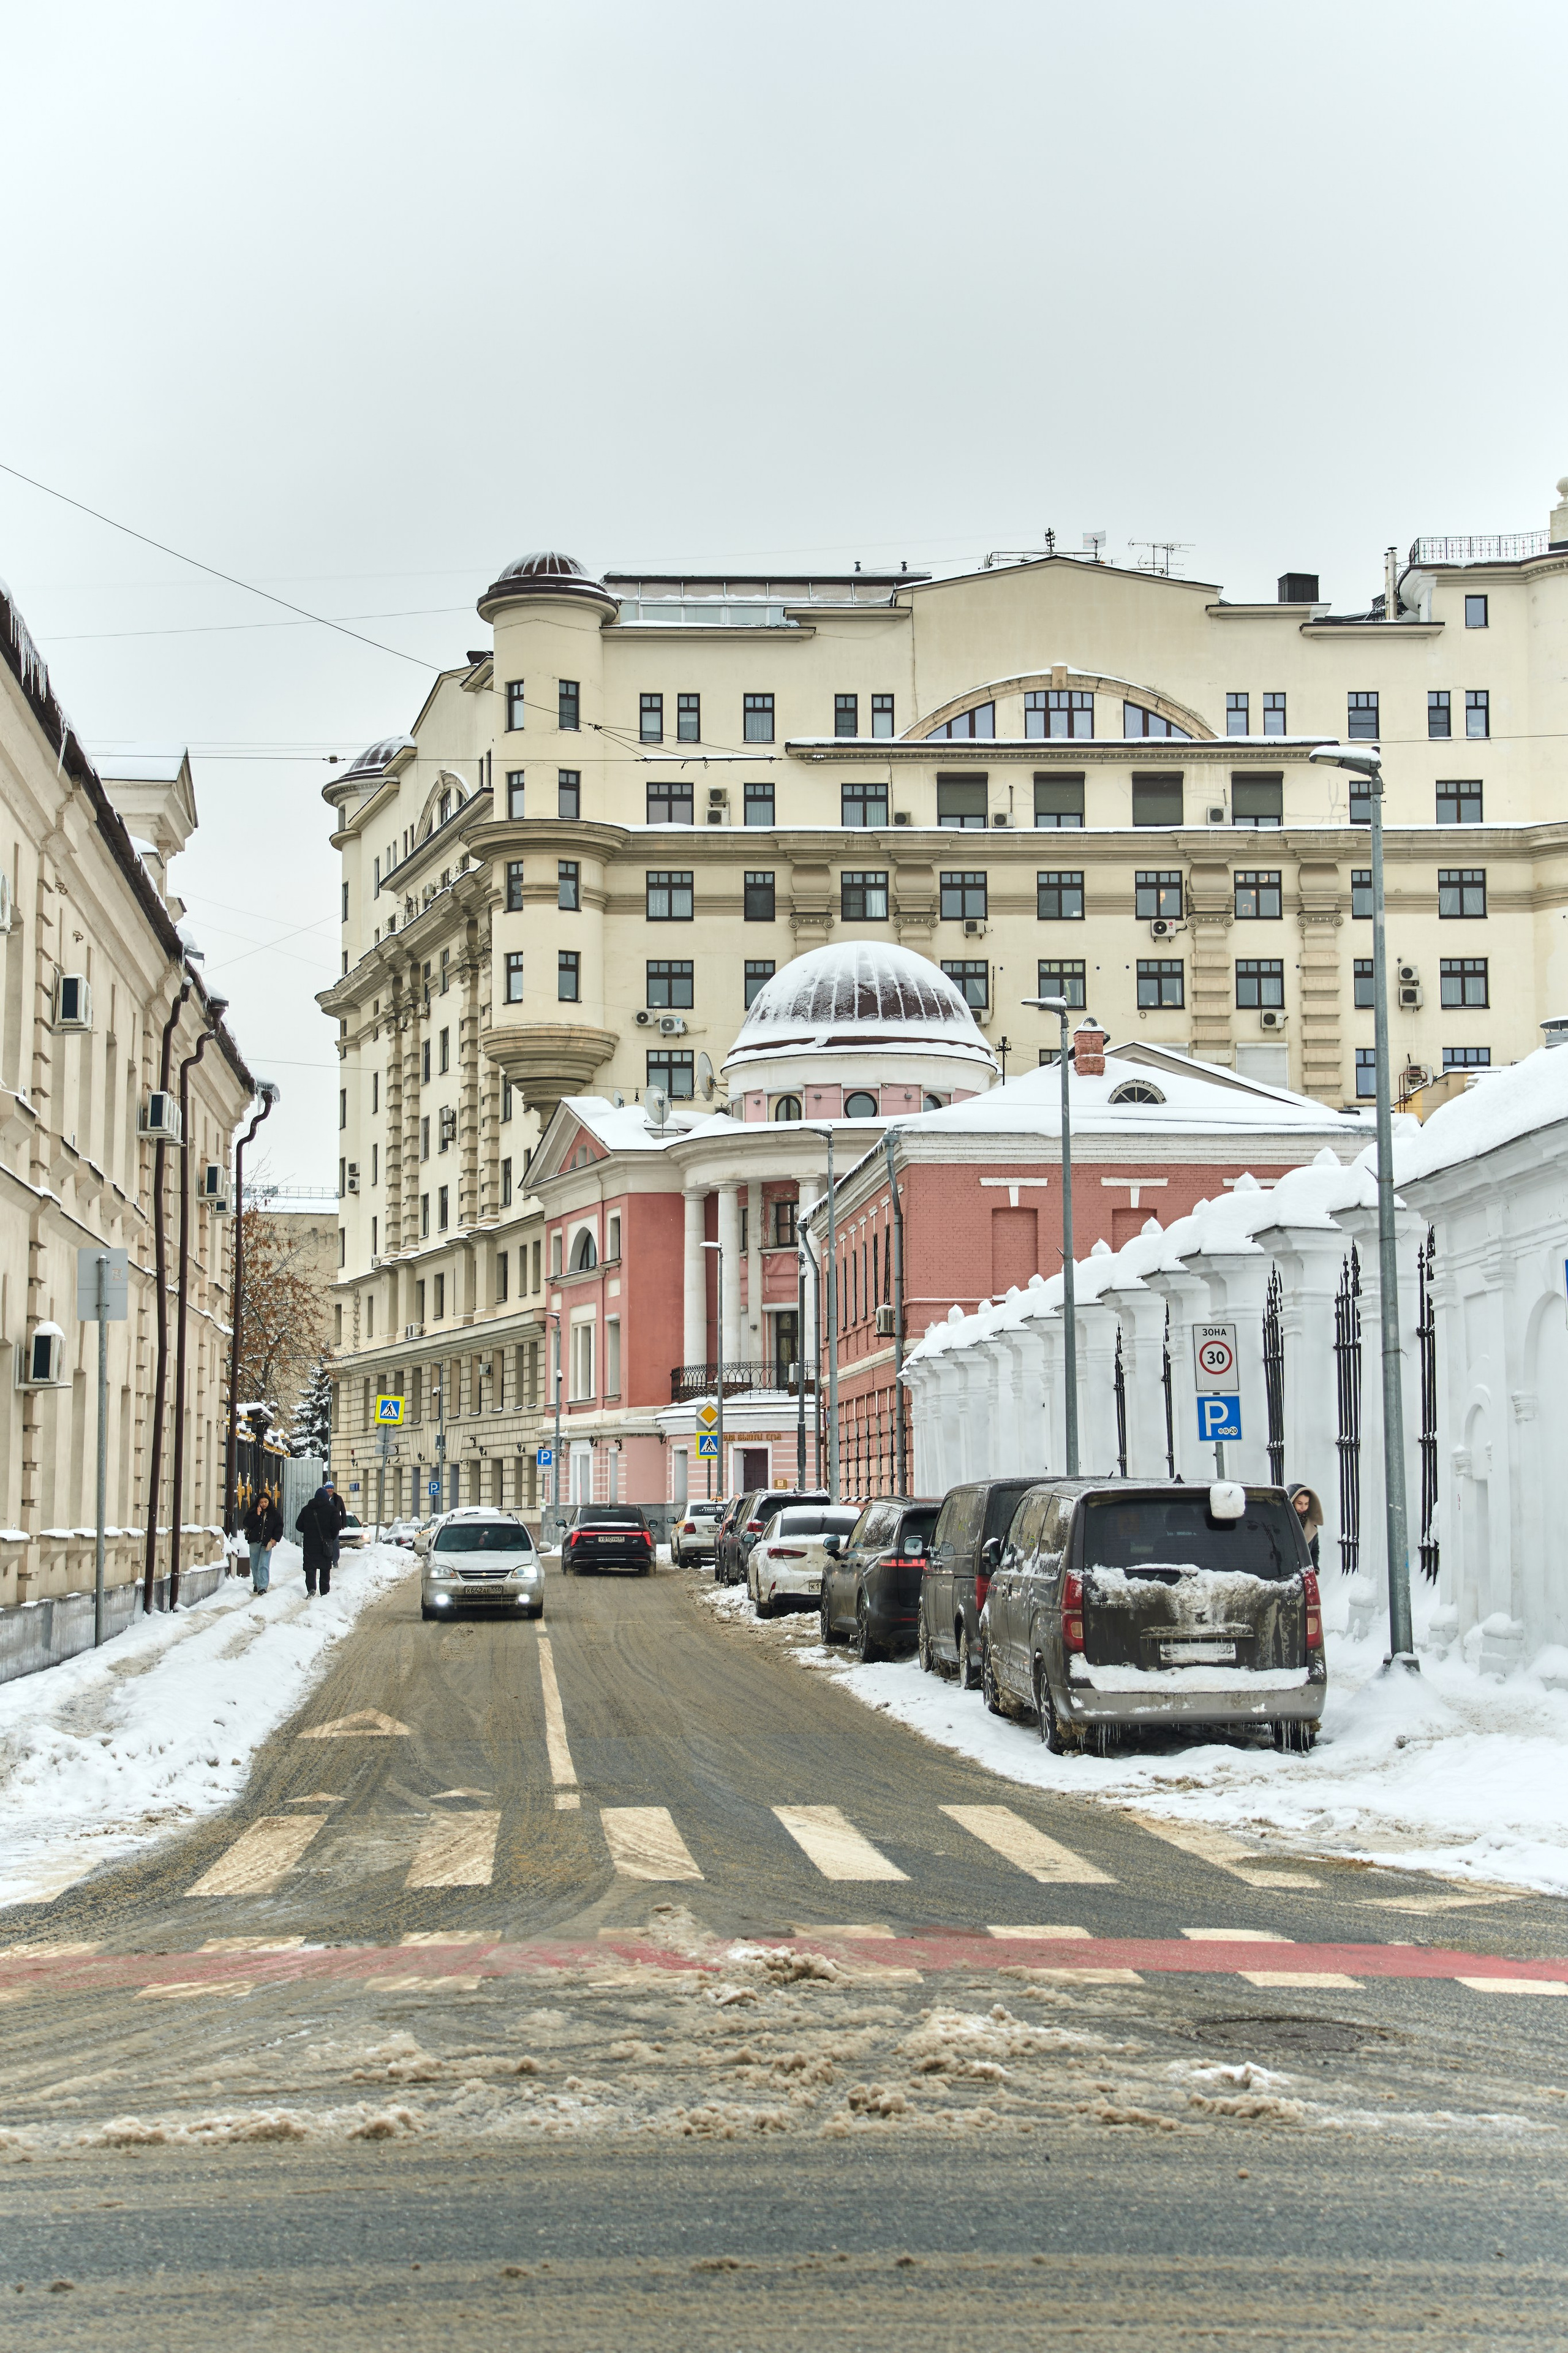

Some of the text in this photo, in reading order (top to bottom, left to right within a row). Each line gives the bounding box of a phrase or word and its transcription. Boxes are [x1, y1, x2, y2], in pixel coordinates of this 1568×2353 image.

[1207, 1351, 1225, 1364] 30
[1204, 1400, 1229, 1437] P
[541, 1451, 550, 1464] P
[431, 1482, 438, 1494] P
